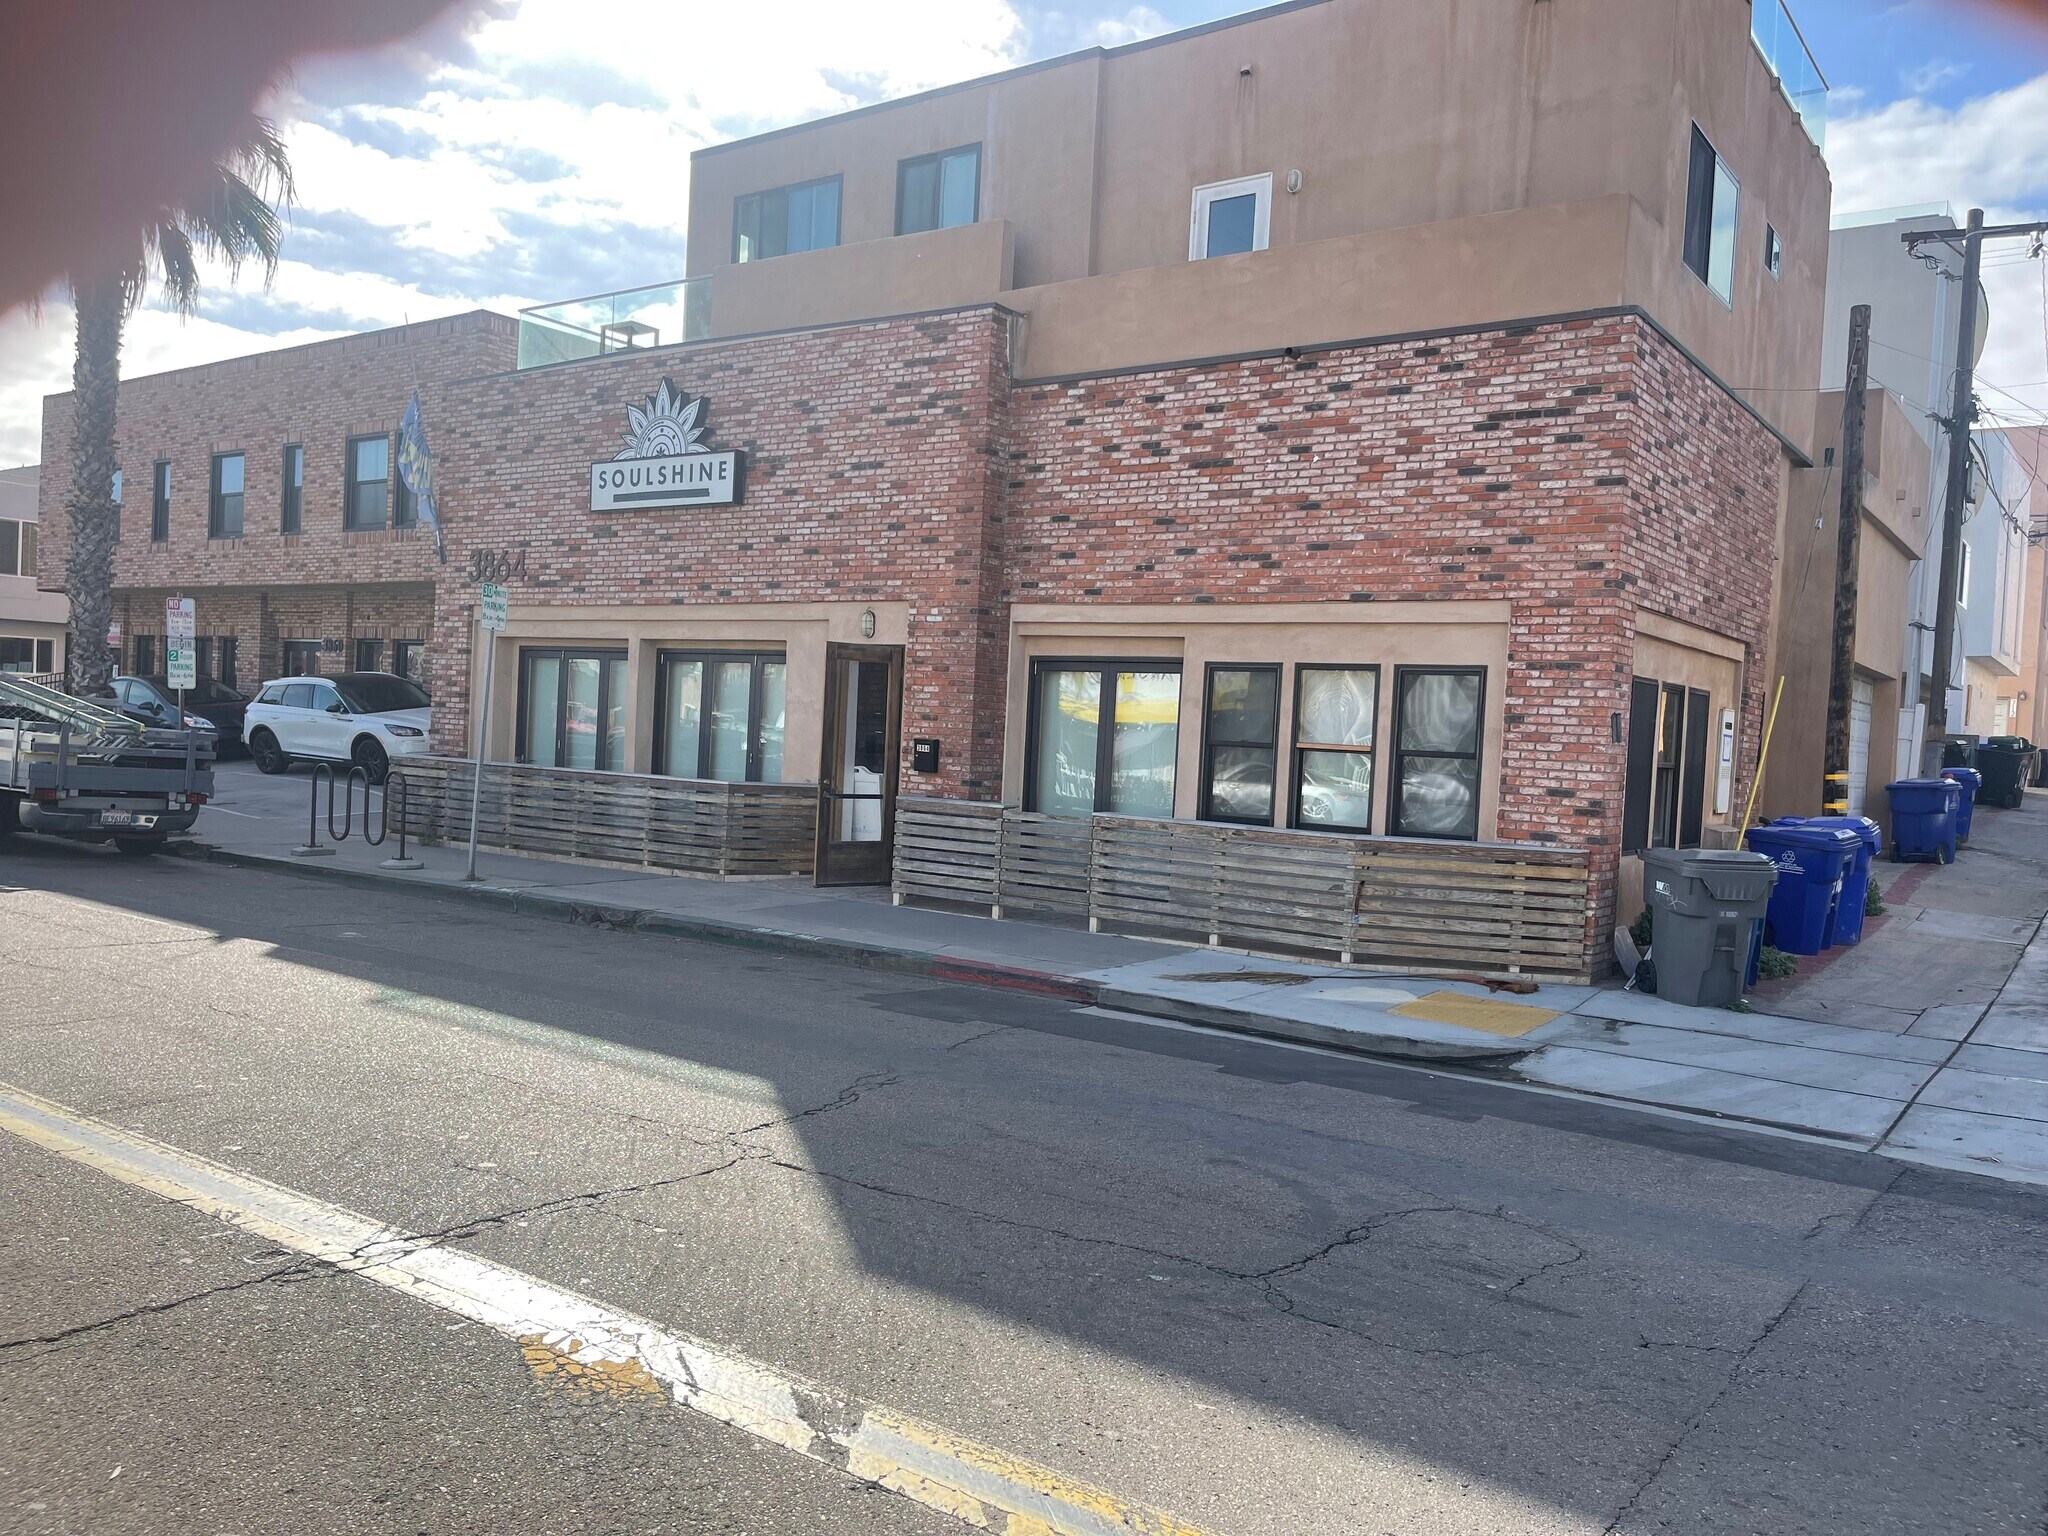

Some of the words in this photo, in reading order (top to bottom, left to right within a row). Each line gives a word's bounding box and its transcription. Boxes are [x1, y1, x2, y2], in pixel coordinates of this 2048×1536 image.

[599, 460, 727, 489] SOULSHINE
[468, 549, 527, 582] 3864
[483, 585, 493, 597] 30
[168, 600, 180, 609] NO
[484, 601, 506, 612] PARKING
[169, 611, 193, 619] PARKING
[170, 640, 192, 649] BEGIN
[170, 652, 177, 661] 2
[170, 663, 194, 671] PARKING
